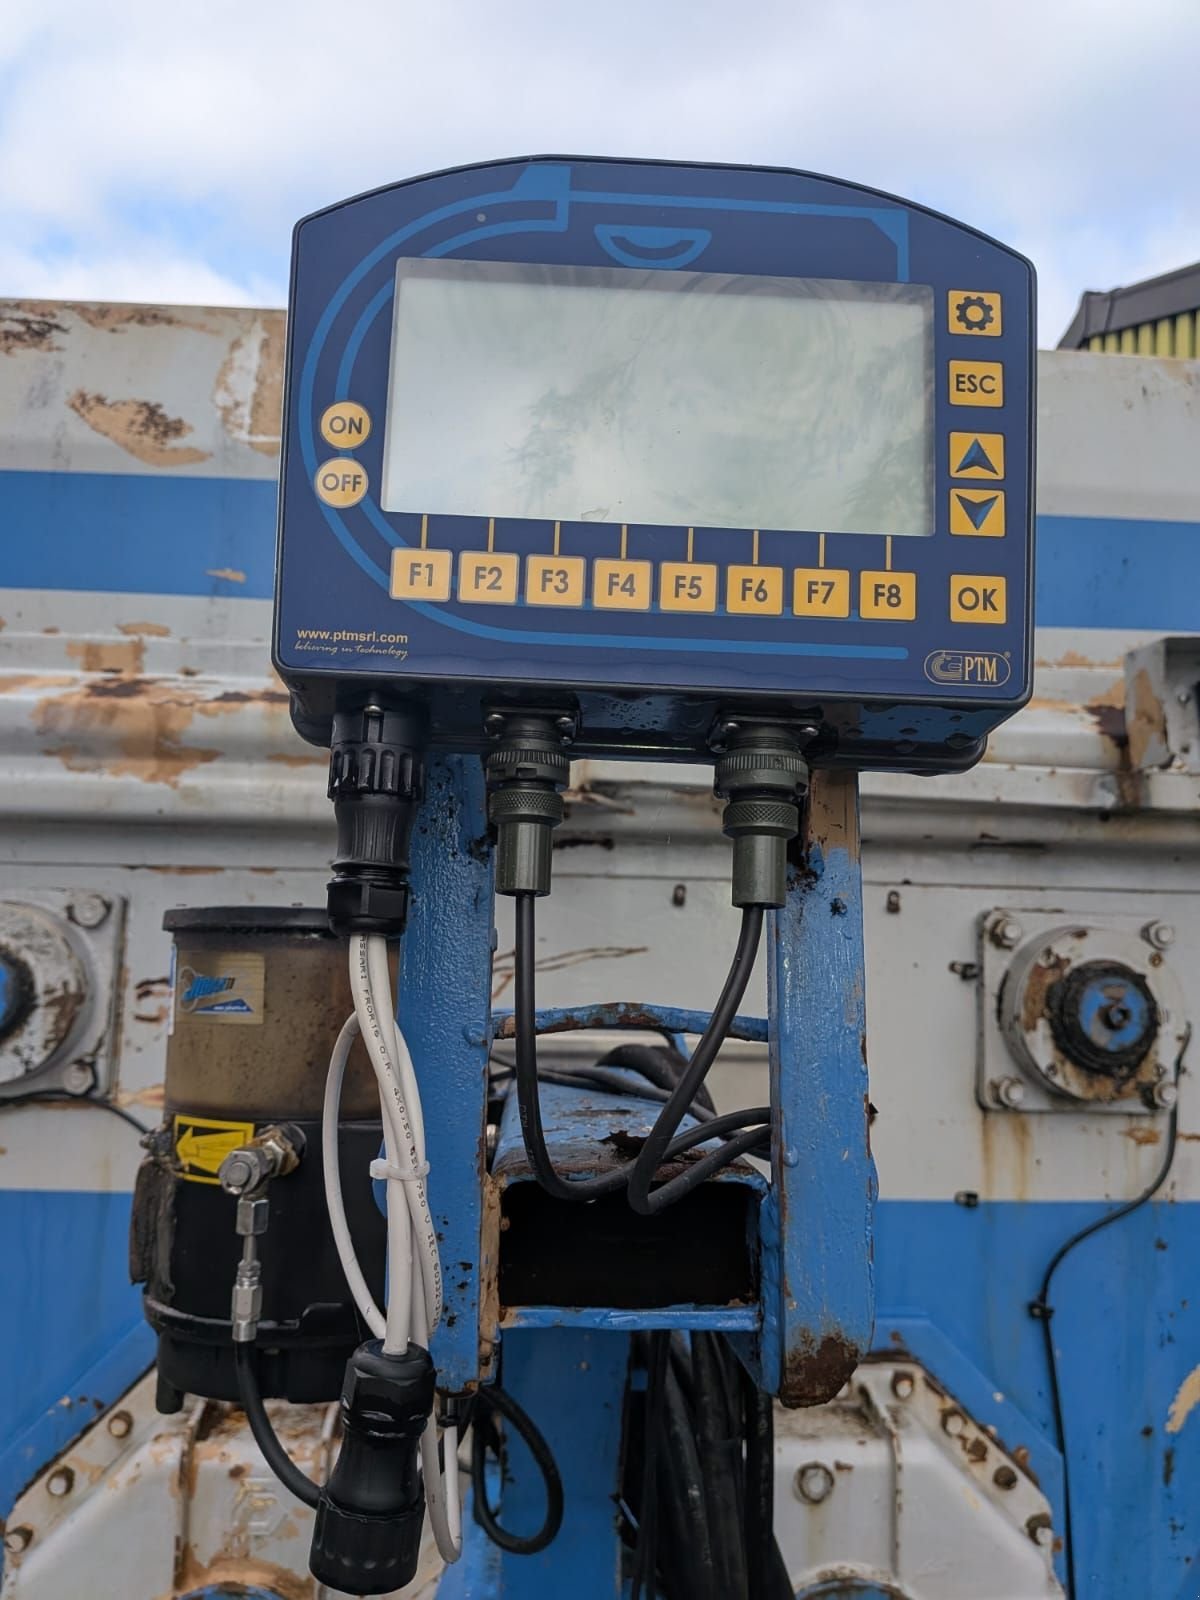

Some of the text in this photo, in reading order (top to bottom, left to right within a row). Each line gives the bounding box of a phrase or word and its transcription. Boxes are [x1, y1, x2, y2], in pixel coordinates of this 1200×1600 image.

[955, 373, 997, 395] ESC
[329, 415, 363, 435] ON
[322, 472, 362, 493] OFF
[408, 562, 902, 608] F1 F2 F3 F4 F5 F6 F7 F8
[957, 586, 998, 612] OK
[296, 629, 408, 644] www.ptmsrl.com
[293, 640, 338, 656] believing
[355, 643, 409, 661] technology
[964, 656, 998, 682] PTM
